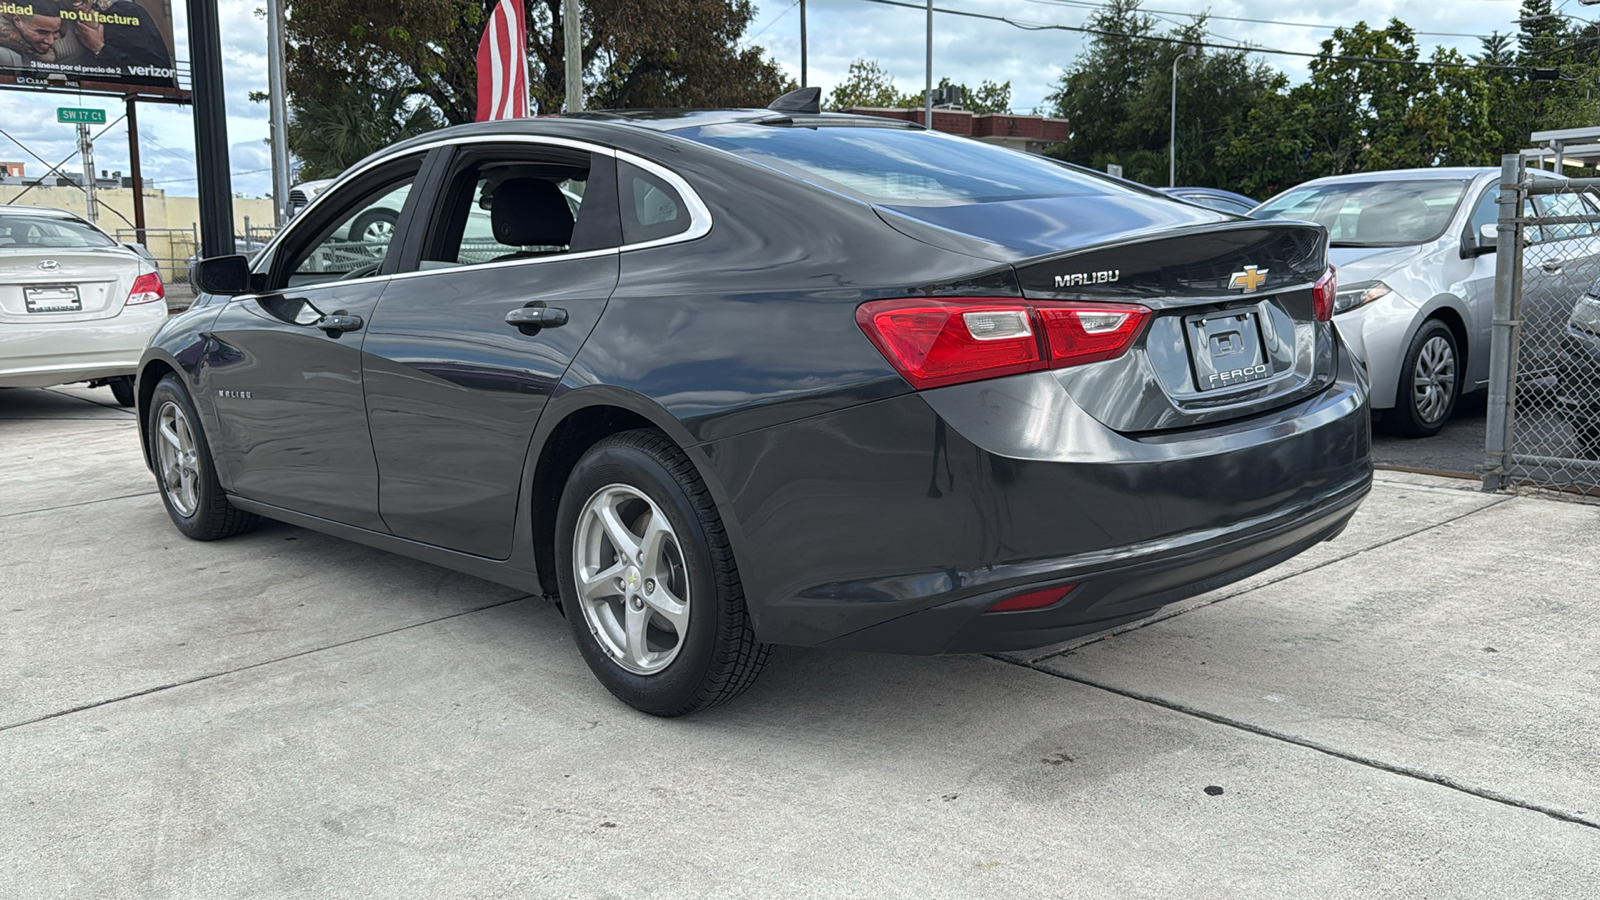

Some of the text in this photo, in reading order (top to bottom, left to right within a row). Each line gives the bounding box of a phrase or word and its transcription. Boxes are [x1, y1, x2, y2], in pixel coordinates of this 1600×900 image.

[60, 10, 140, 26] no tu factura
[127, 65, 176, 78] verizon
[62, 110, 103, 121] SW 17 Ct
[1054, 269, 1120, 288] MALIBU
[1208, 364, 1266, 383] FERCO
